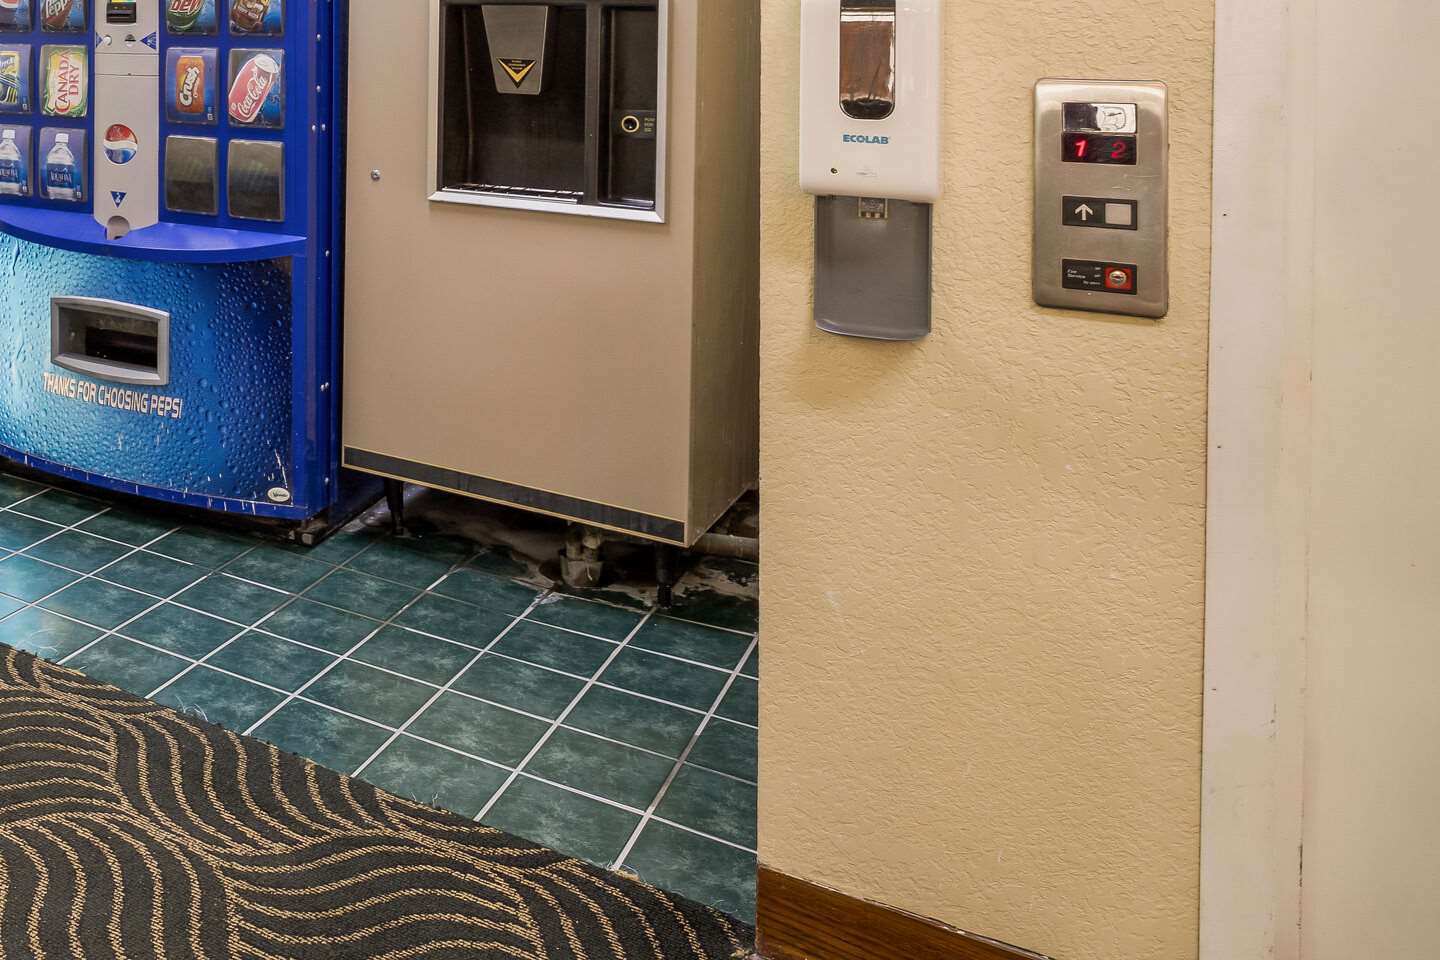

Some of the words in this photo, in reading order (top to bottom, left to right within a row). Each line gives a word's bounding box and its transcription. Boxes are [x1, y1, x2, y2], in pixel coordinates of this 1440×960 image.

[68, 65, 80, 96] DRY
[843, 134, 889, 145] ECOLAB
[1075, 140, 1086, 157] 1
[1111, 141, 1127, 159] 2
[44, 372, 75, 399] THANKS
[76, 382, 97, 402] FOR
[98, 385, 149, 414] CHOOSING
[150, 395, 183, 419] PEPSI
